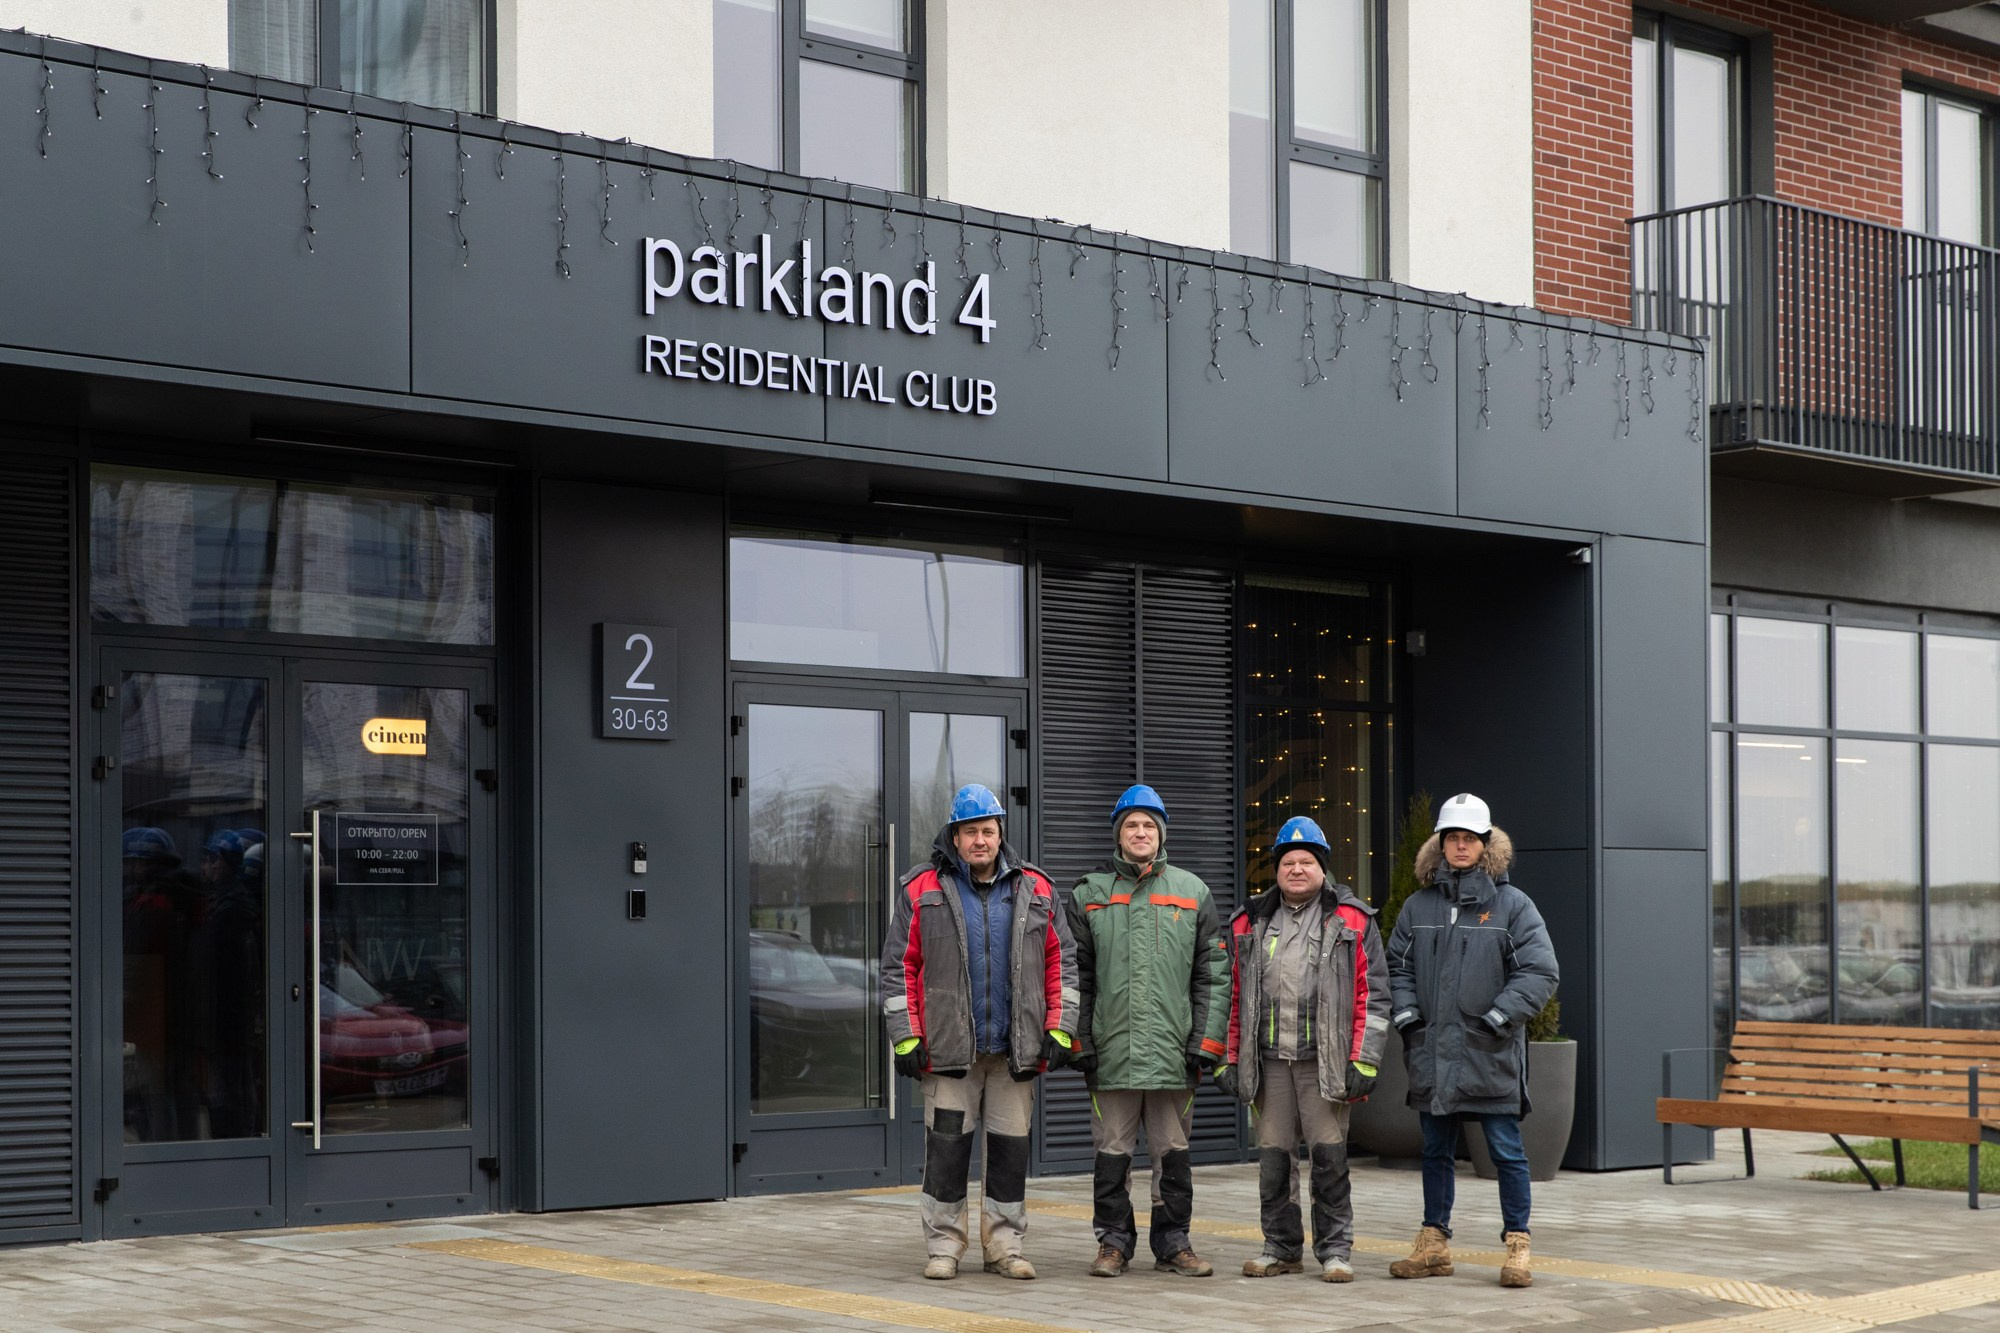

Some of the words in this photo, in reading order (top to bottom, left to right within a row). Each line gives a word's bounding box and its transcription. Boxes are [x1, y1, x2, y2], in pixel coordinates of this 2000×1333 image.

[643, 233, 936, 335] parkland
[958, 273, 997, 343] 4
[644, 334, 896, 404] RESIDENTIAL
[905, 370, 998, 416] CLUB
[625, 633, 655, 690] 2
[612, 708, 669, 732] 30-63
[356, 849, 382, 859] 10:00
[392, 849, 419, 859] 22:00
